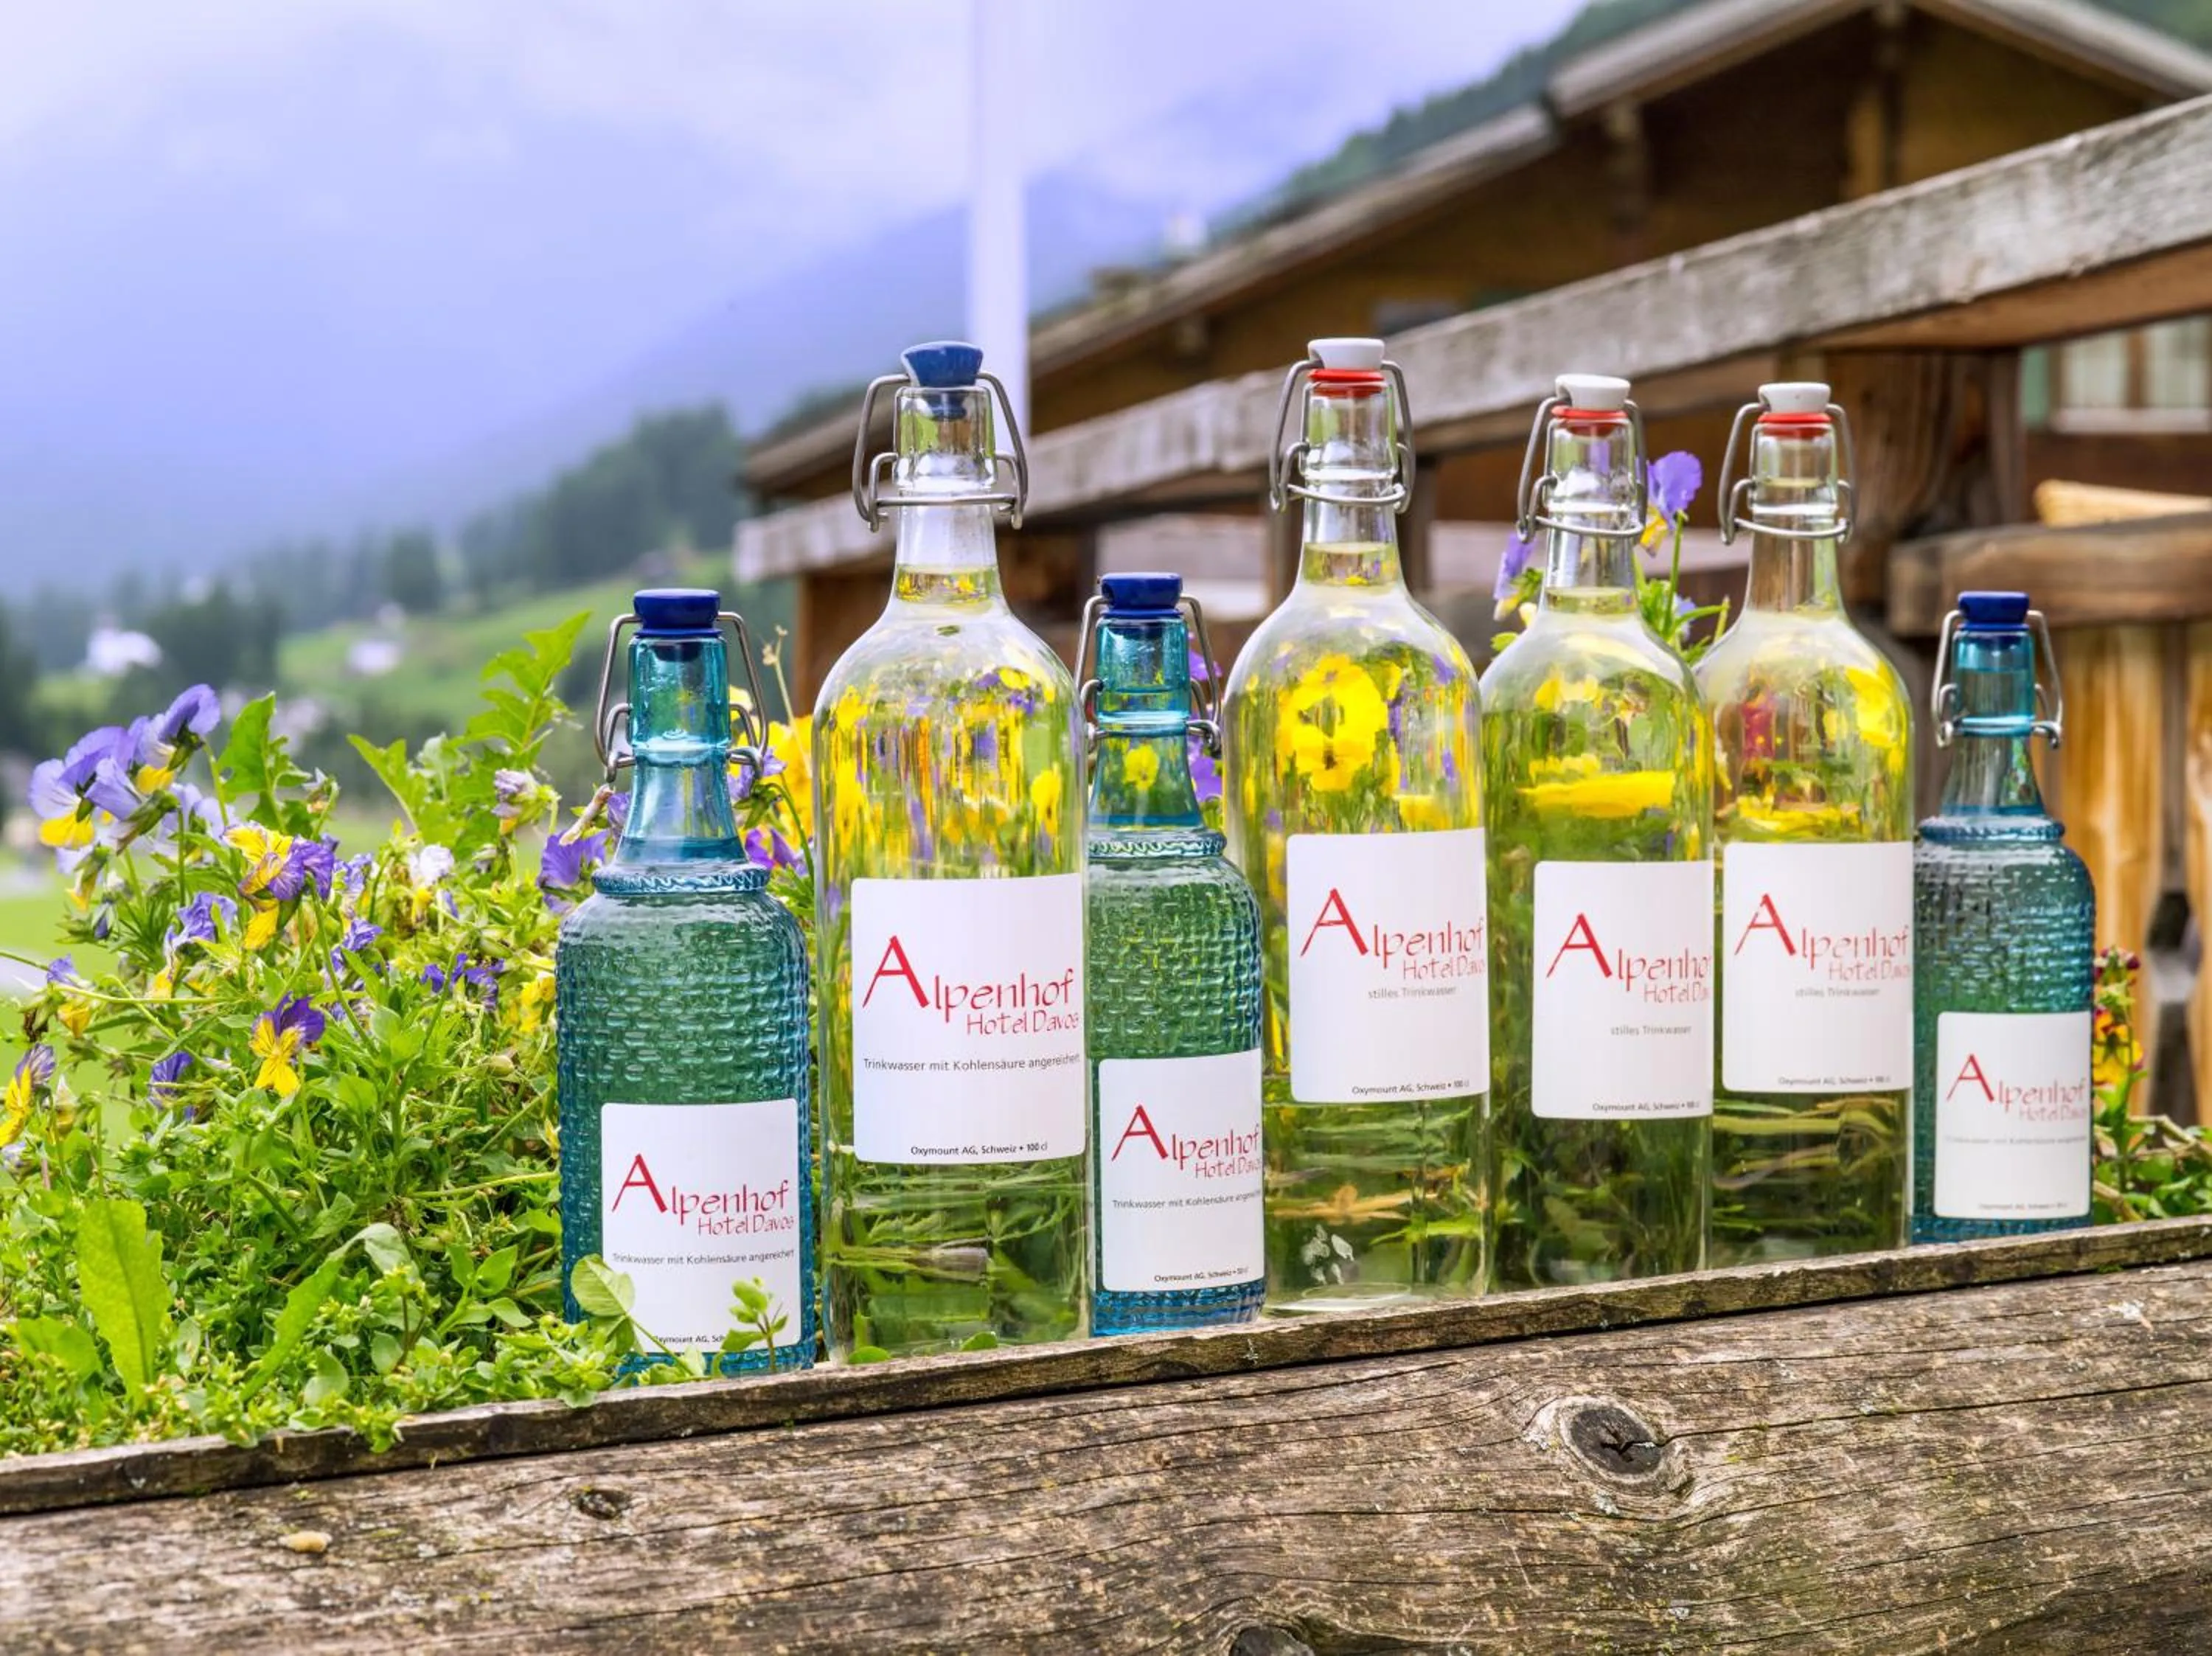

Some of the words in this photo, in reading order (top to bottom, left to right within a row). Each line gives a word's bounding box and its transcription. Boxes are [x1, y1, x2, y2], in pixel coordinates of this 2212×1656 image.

[1300, 888, 1484, 970] Alpenhof
[1734, 893, 1909, 970] Alpenhof
[1545, 912, 1711, 992] Alpenho
[862, 934, 1074, 1023] Alpenhof
[1403, 957, 1453, 980] Hotel
[1829, 960, 1877, 981] Hotel
[1644, 983, 1689, 1003] Hotel
[967, 1011, 1028, 1035] Hotel
[1033, 1009, 1079, 1033] Davos
[863, 1058, 925, 1071] Trinkwasser
[930, 1060, 949, 1071] mit
[953, 1057, 1026, 1071] Kohlensäure
[1352, 1085, 1397, 1096] Oxymount
[1111, 1104, 1260, 1170] Alpenhof
[911, 1146, 959, 1158] Oxymount
[981, 1144, 1017, 1155] Schweiz
[1027, 1142, 1040, 1152] 100
[1195, 1158, 1236, 1179] Hotel
[612, 1153, 790, 1225] Alpenhof
[1112, 1199, 1164, 1210] Trinkwasser
[1169, 1198, 1183, 1208] mit
[698, 1215, 748, 1236] Hotel
[753, 1214, 795, 1234] Davos
[612, 1253, 664, 1265] Trinkwasser
[667, 1255, 684, 1265] mit
[686, 1252, 747, 1264] Kohlensäure
[655, 1335, 693, 1344] xymount
